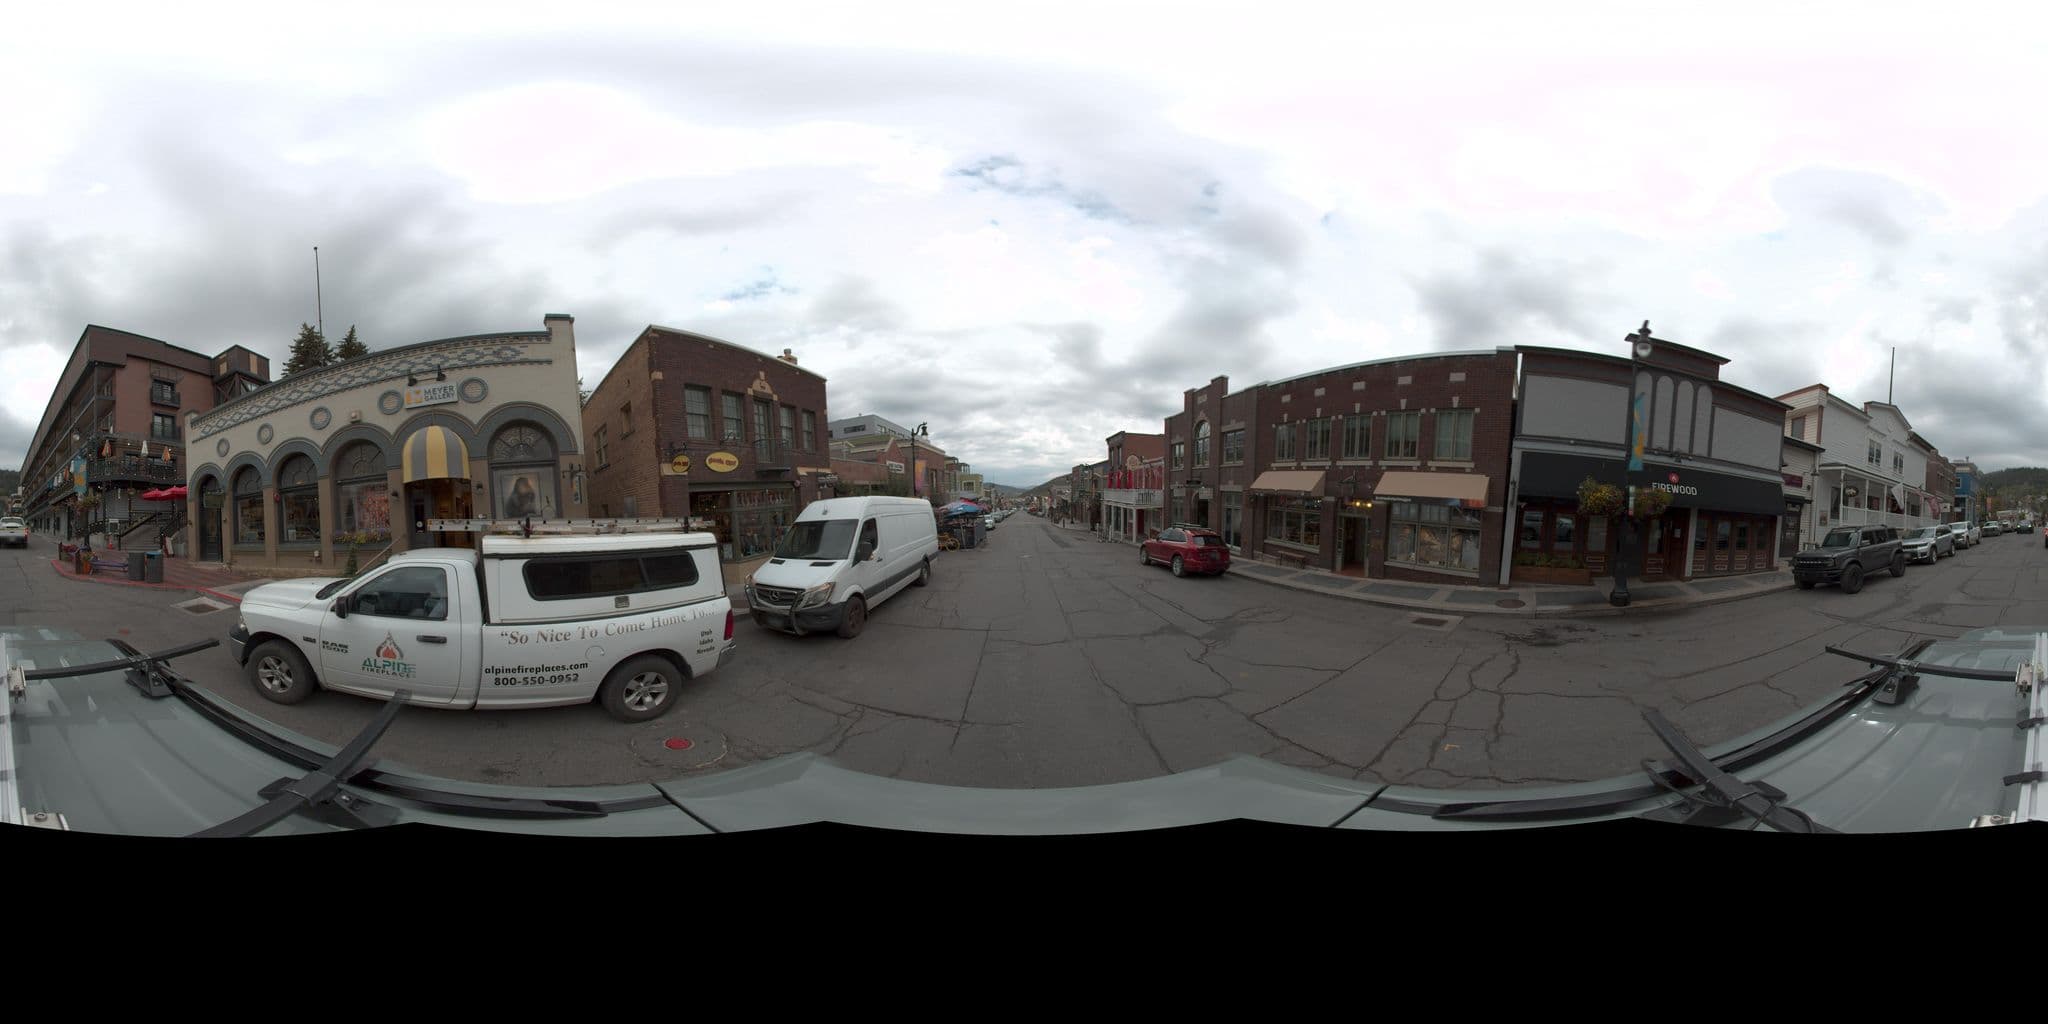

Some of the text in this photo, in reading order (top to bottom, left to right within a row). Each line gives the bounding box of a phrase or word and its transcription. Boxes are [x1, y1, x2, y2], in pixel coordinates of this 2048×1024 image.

[424, 385, 455, 396] MEYER
[424, 391, 456, 401] GALLERY
[1652, 482, 1698, 496] FIREWOOD
[536, 629, 572, 644] Nice
[578, 625, 598, 640] To
[604, 622, 646, 637] Come
[651, 614, 687, 629] Home
[700, 628, 713, 638] Utah
[699, 638, 714, 646] Idaho
[362, 657, 417, 673] ALPINE
[484, 661, 589, 676] alpinefireplaces.com
[494, 673, 579, 686] 800-550-0952
